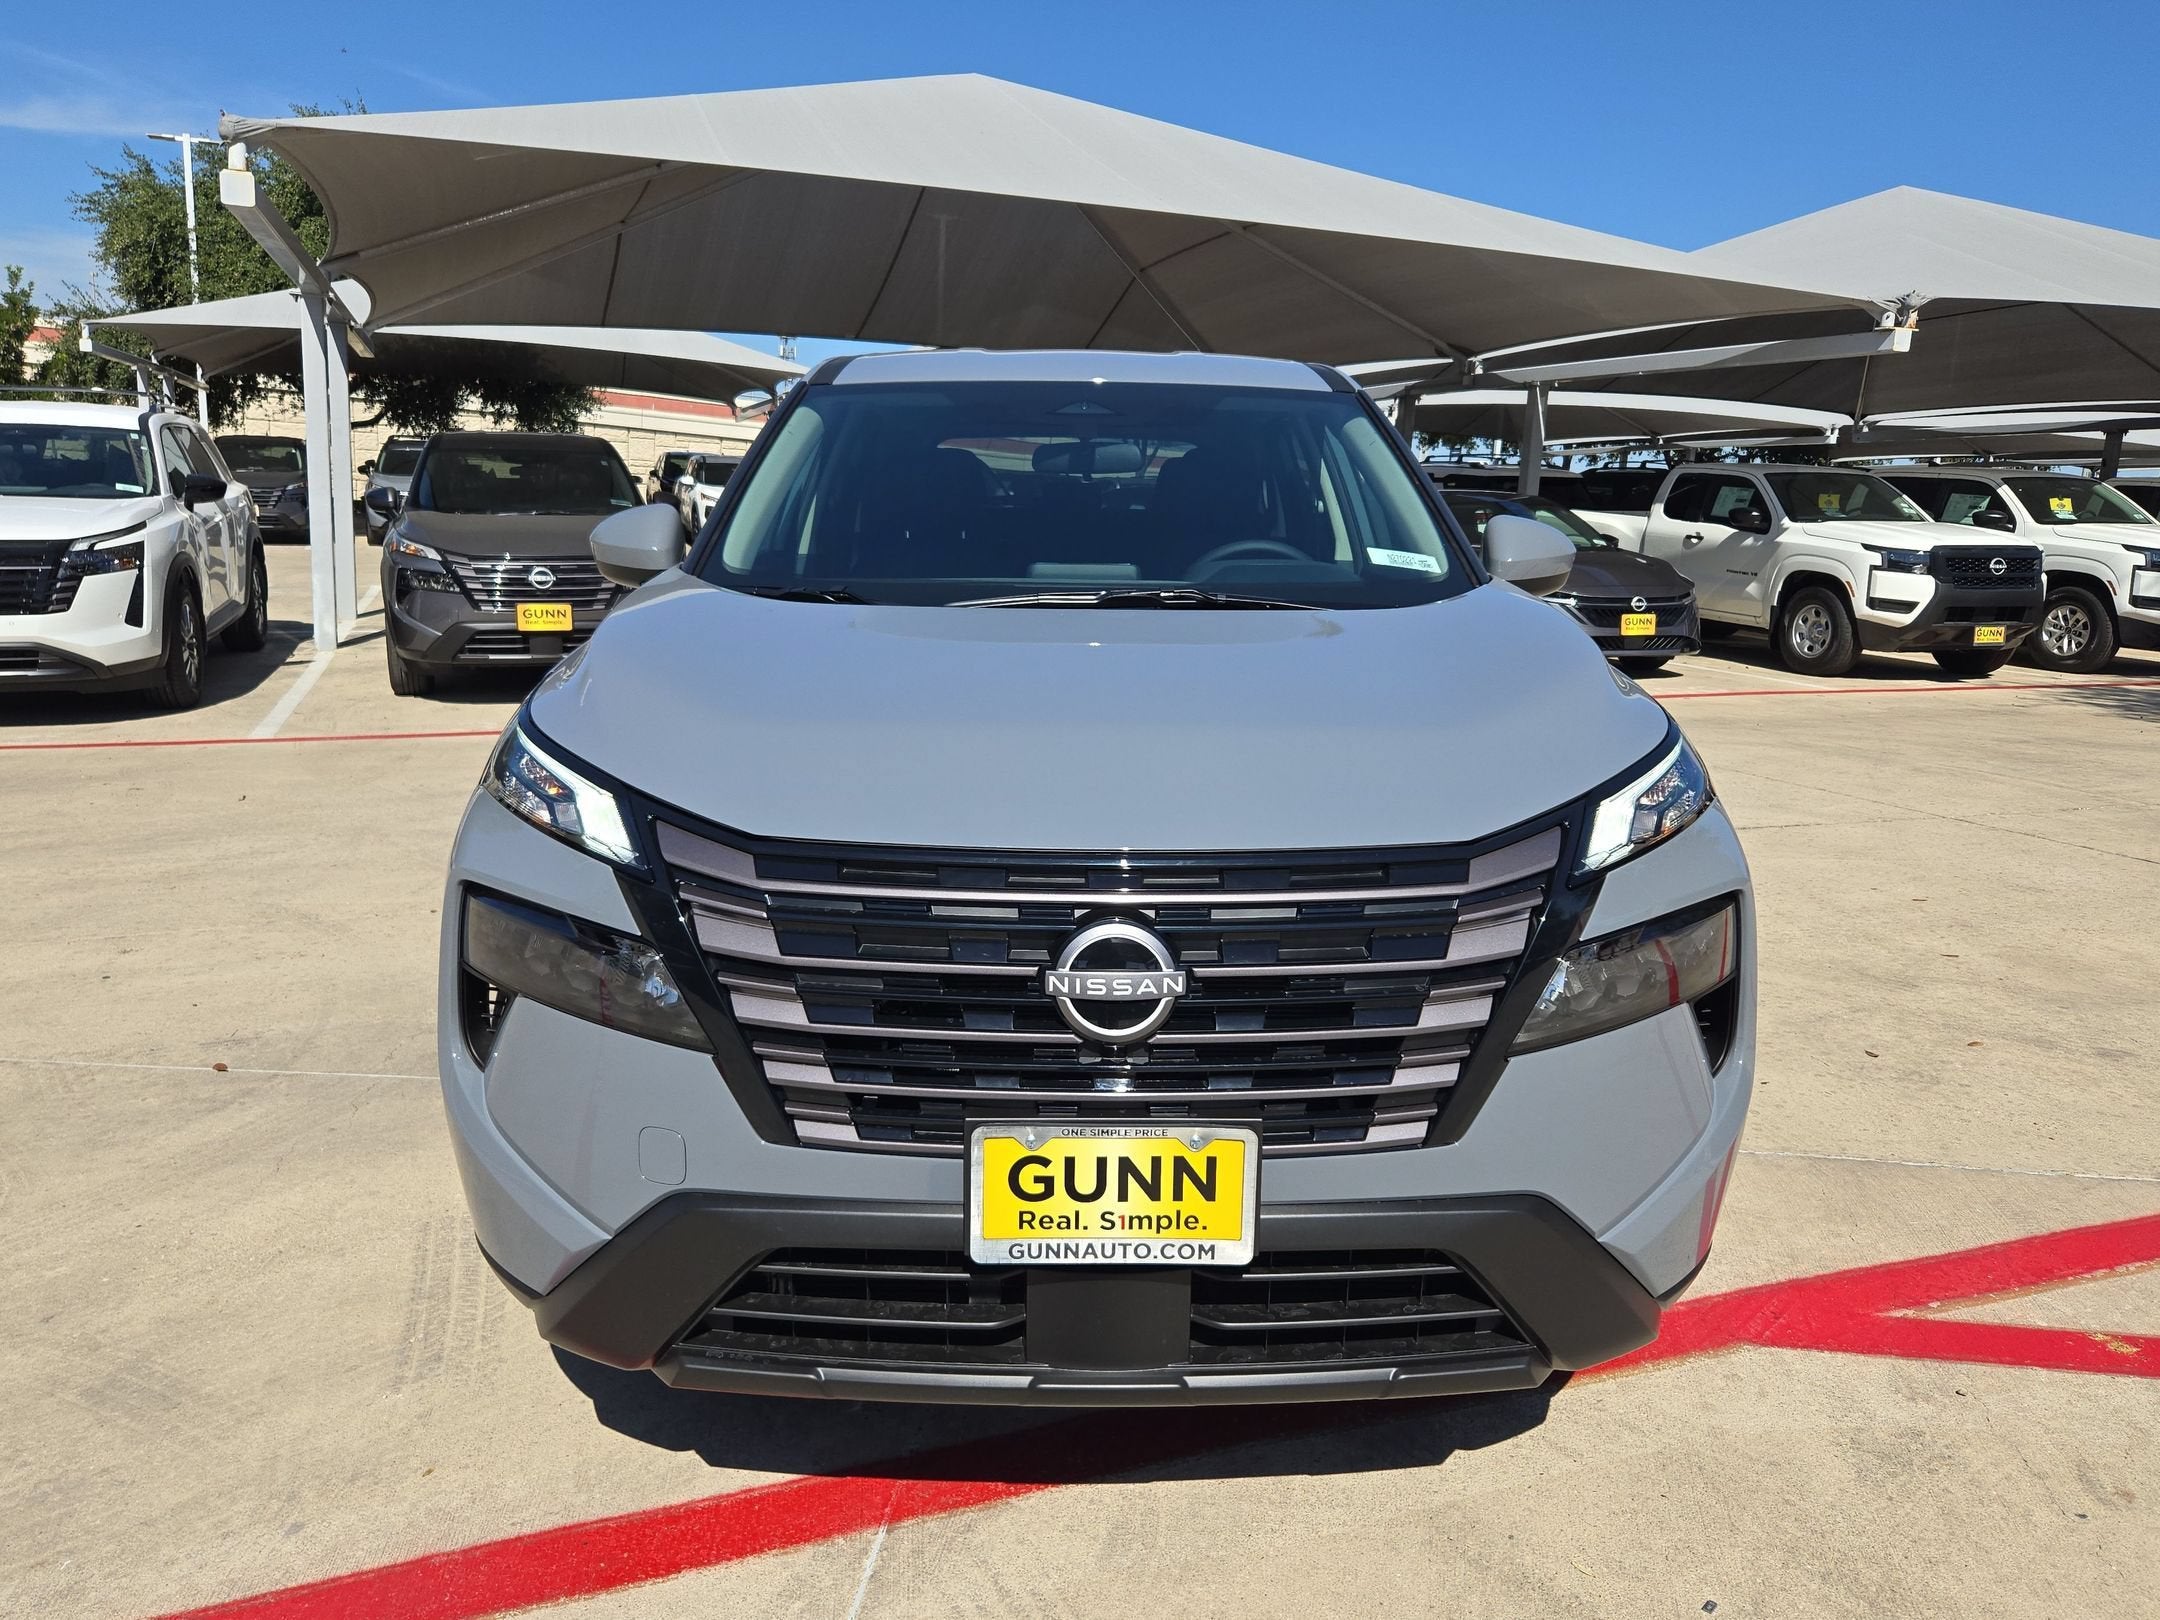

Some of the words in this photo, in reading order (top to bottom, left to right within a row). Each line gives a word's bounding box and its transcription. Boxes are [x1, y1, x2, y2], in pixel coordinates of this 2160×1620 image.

[523, 609, 567, 619] GUNN
[1625, 618, 1653, 626] GUNN
[1976, 629, 2003, 637] GUNN
[1049, 975, 1183, 995] NISSAN
[1061, 1128, 1087, 1137] ONE
[1090, 1128, 1132, 1137] SIMPLE
[1134, 1128, 1169, 1137] PRICE
[1008, 1155, 1217, 1203] GUNN
[1018, 1210, 1088, 1231] Real.
[1008, 1242, 1216, 1260] GUNNAUTO.COM
